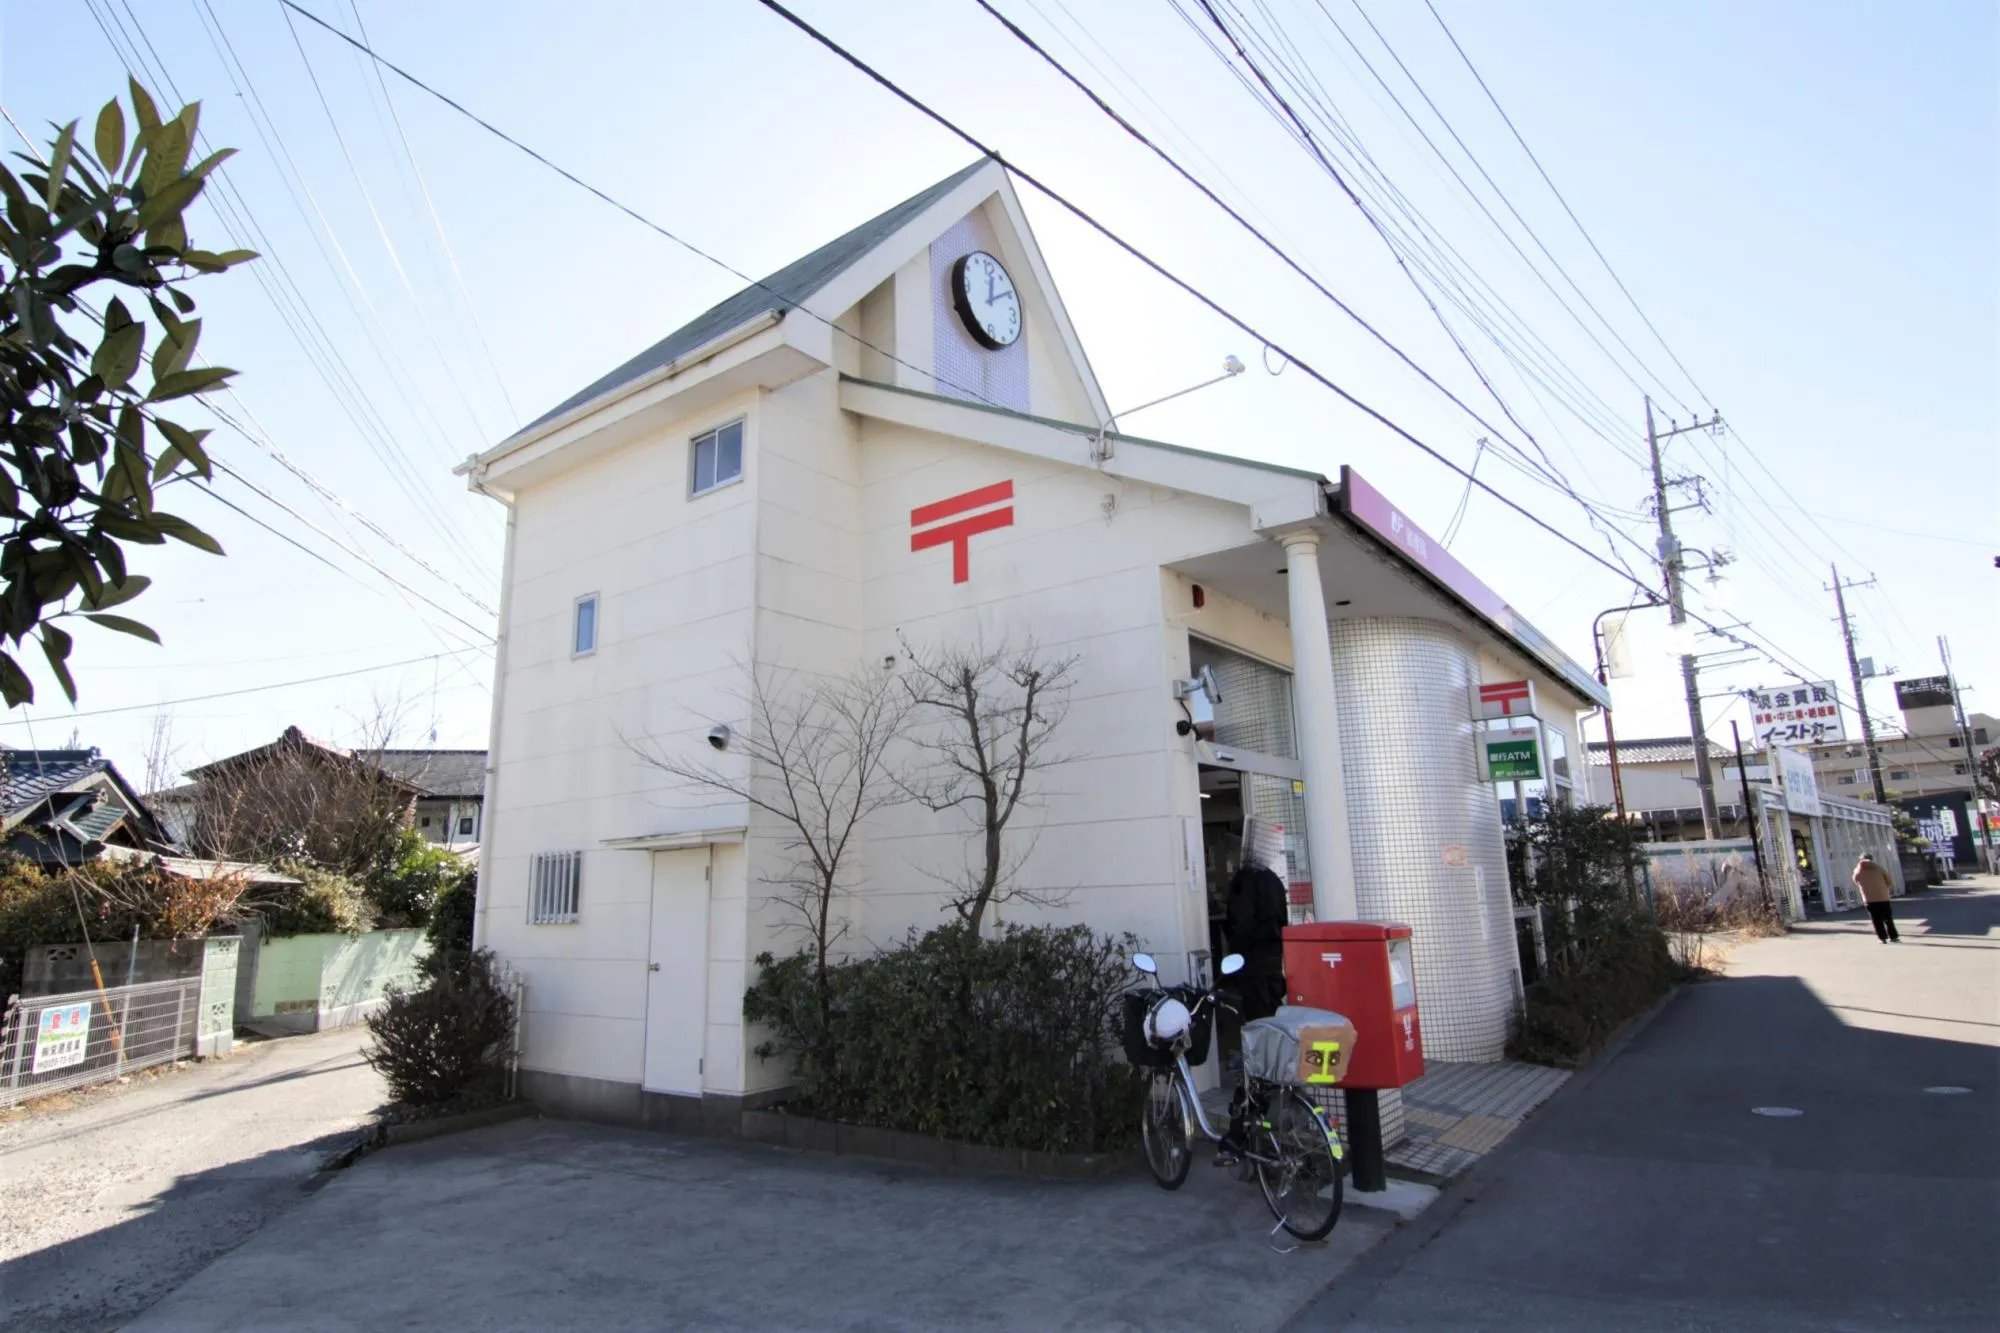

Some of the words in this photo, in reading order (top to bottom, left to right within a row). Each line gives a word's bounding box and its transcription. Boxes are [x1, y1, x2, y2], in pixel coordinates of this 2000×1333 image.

[1008, 307, 1017, 324] 3
[987, 323, 996, 341] 6
[1758, 687, 1828, 710] 現金買取
[1761, 722, 1837, 742] イーストカー
